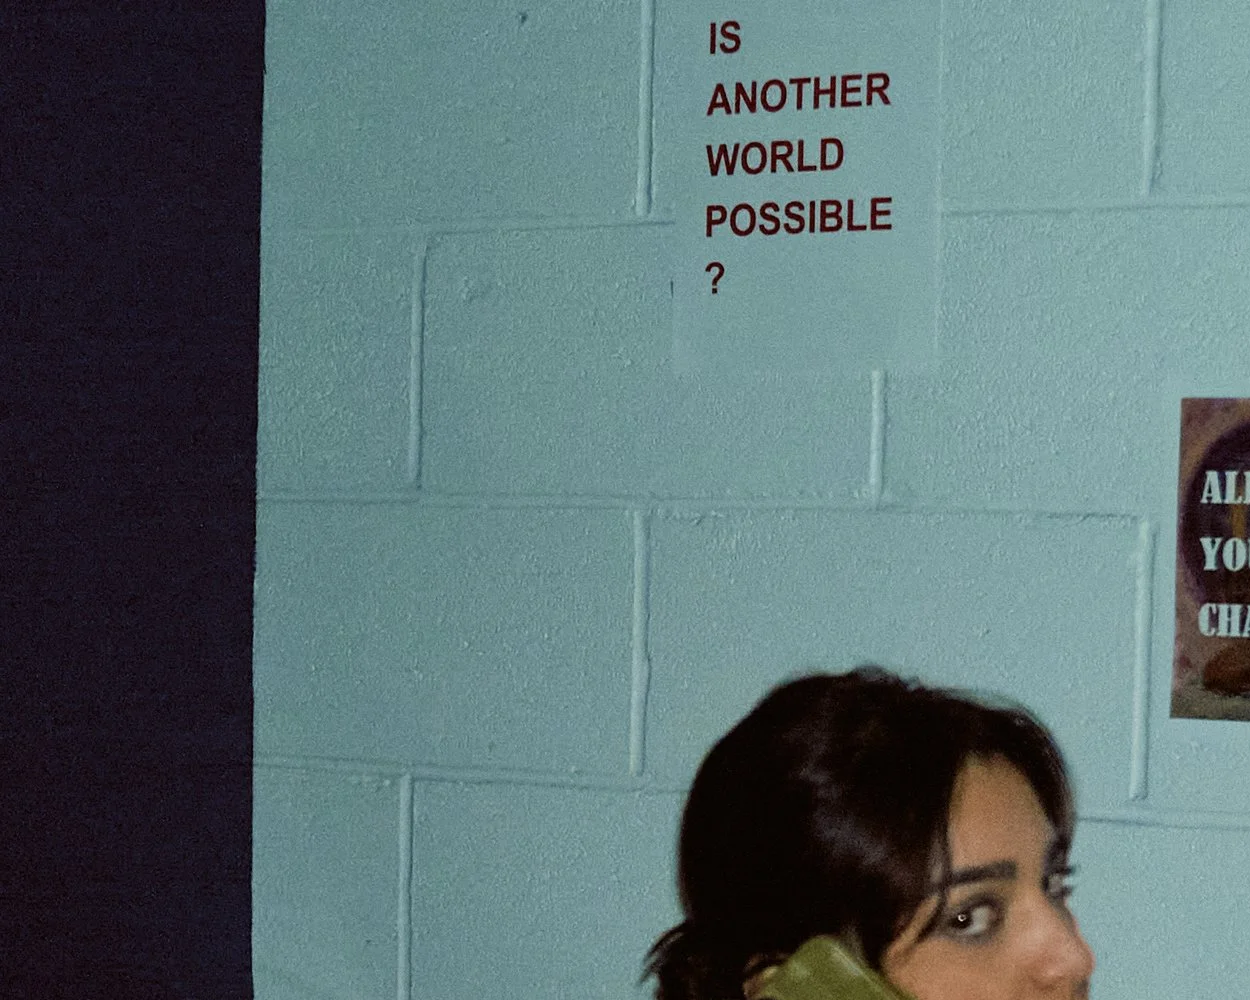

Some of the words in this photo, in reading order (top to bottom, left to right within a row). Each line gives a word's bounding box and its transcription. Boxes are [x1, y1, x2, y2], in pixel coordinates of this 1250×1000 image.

[708, 21, 742, 54] IS
[706, 73, 891, 116] ANOTHER
[706, 138, 844, 176] WORLD
[705, 197, 893, 238] POSSIBLE
[705, 262, 725, 294] ?
